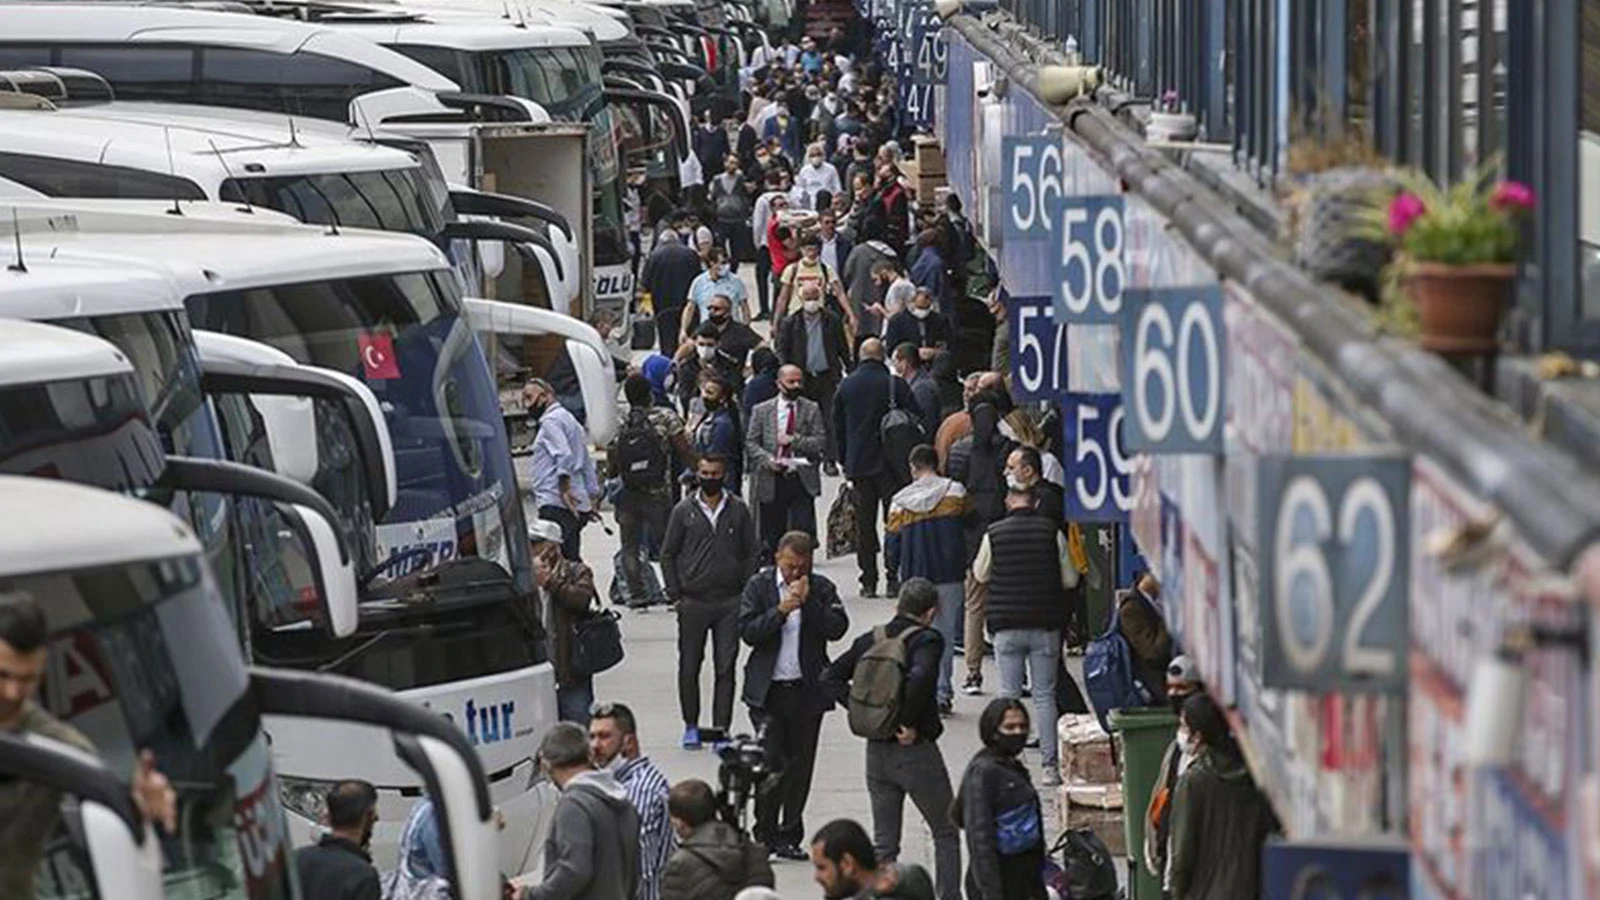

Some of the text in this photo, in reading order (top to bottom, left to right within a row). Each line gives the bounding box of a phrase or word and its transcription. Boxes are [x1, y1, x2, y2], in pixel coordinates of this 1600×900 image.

[1012, 144, 1062, 231] 56
[1062, 206, 1126, 314] 58
[1019, 305, 1064, 393] 57
[1134, 300, 1220, 442] 60
[1075, 403, 1139, 511] 59
[1273, 474, 1396, 672] 62
[465, 698, 514, 746] tur
